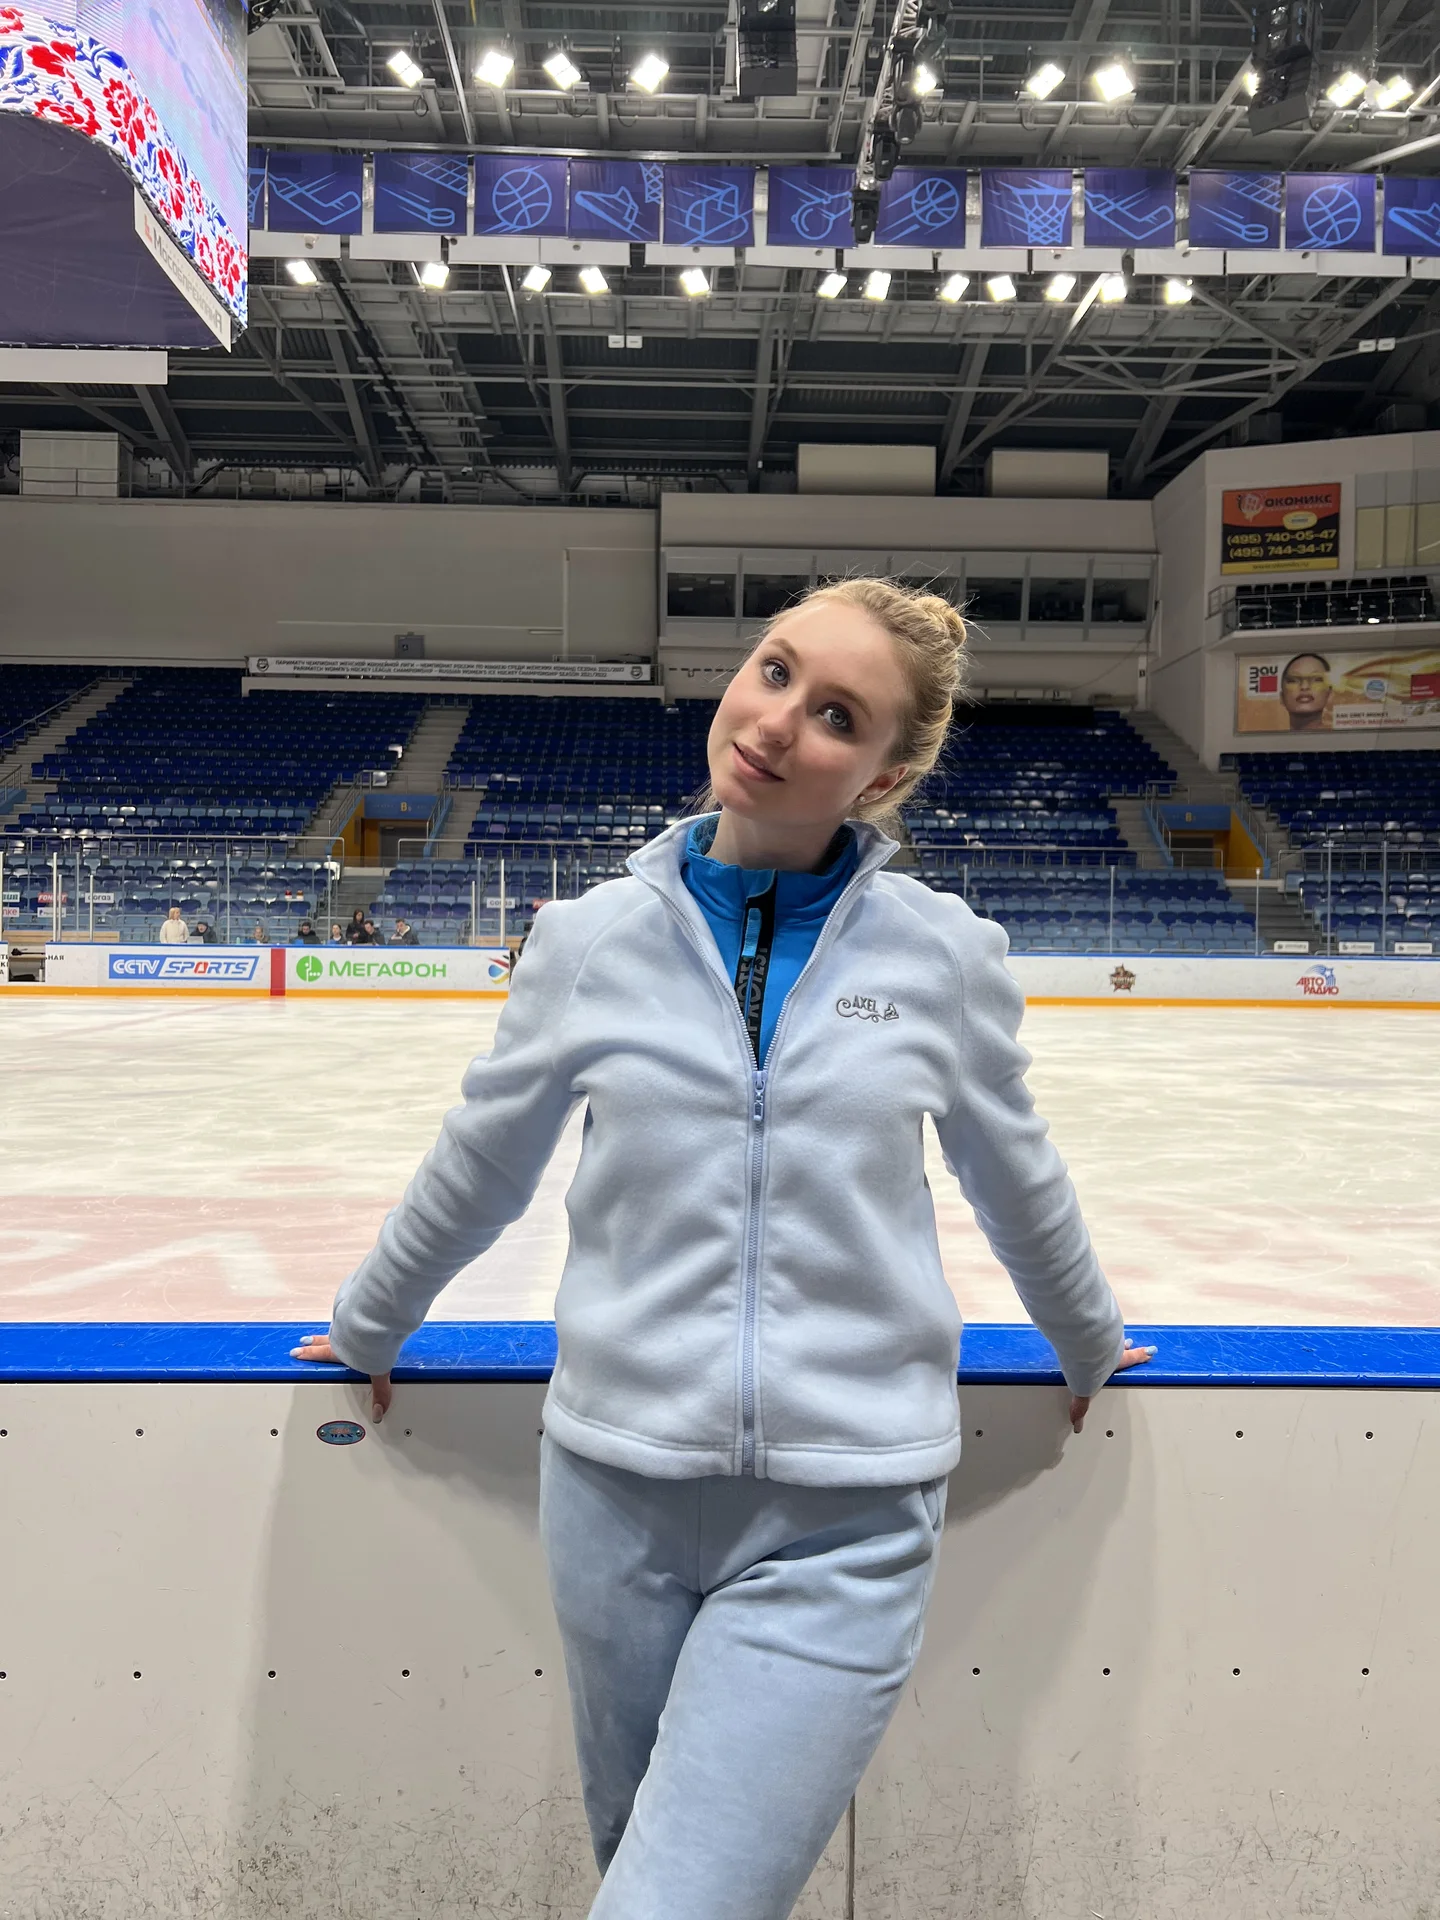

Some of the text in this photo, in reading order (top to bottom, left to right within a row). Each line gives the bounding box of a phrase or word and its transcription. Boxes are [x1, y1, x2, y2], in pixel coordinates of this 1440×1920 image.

[1265, 494, 1333, 507] ОКОНИКС
[1226, 529, 1337, 546] (495) 740-05-47
[1229, 543, 1334, 559] (495) 744-34-17
[112, 958, 250, 977] CCTV SPORTS
[1296, 977, 1325, 986] АВТО
[1303, 986, 1340, 996] РАДИО
[852, 995, 879, 1013] AXEL
